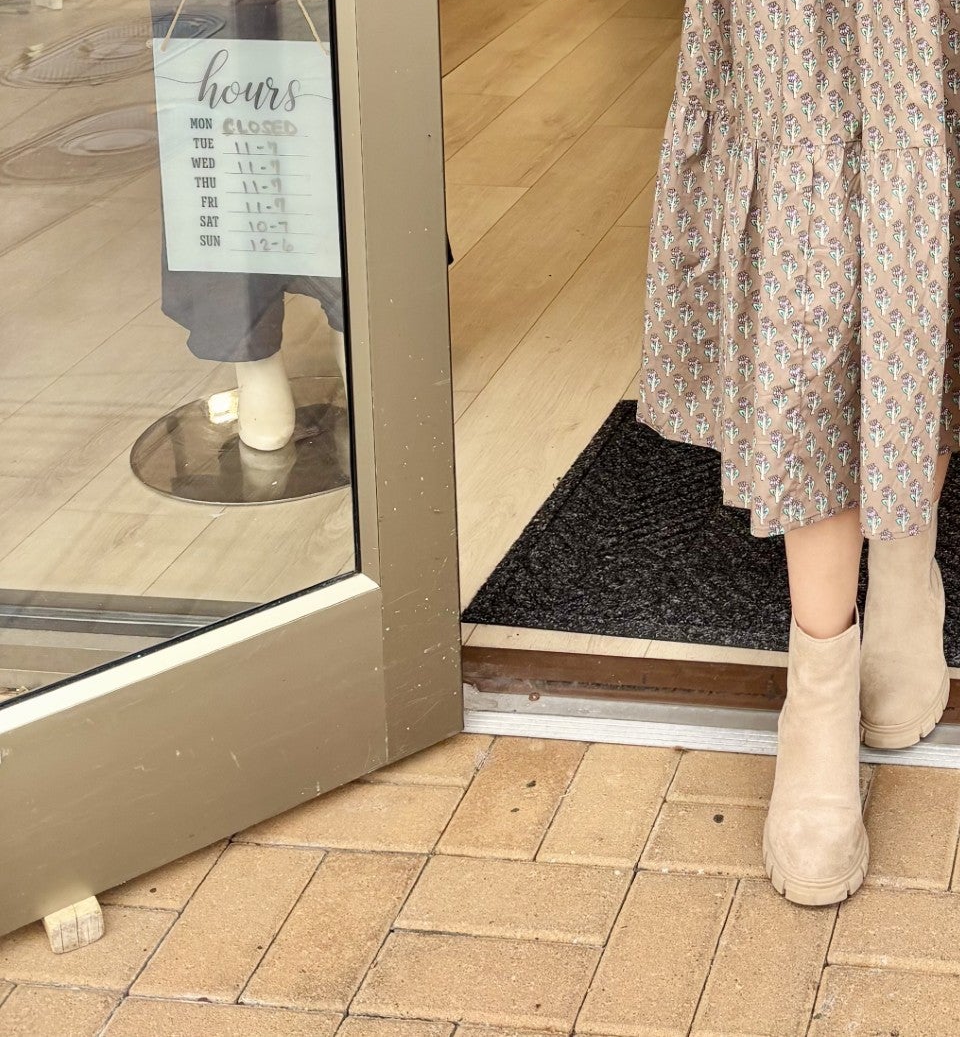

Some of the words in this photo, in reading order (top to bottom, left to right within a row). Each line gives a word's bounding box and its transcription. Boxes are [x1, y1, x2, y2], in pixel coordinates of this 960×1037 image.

[198, 49, 300, 112] hours
[190, 117, 213, 130] MON
[222, 118, 298, 135] CLOSED
[193, 137, 214, 149] TUE
[191, 157, 216, 169] WED
[194, 176, 217, 189] THU
[201, 196, 219, 208] FRI
[200, 215, 220, 228] SAT
[249, 221, 288, 233] 10-7
[200, 234, 221, 247] SUN
[250, 238, 294, 252] 12-6
